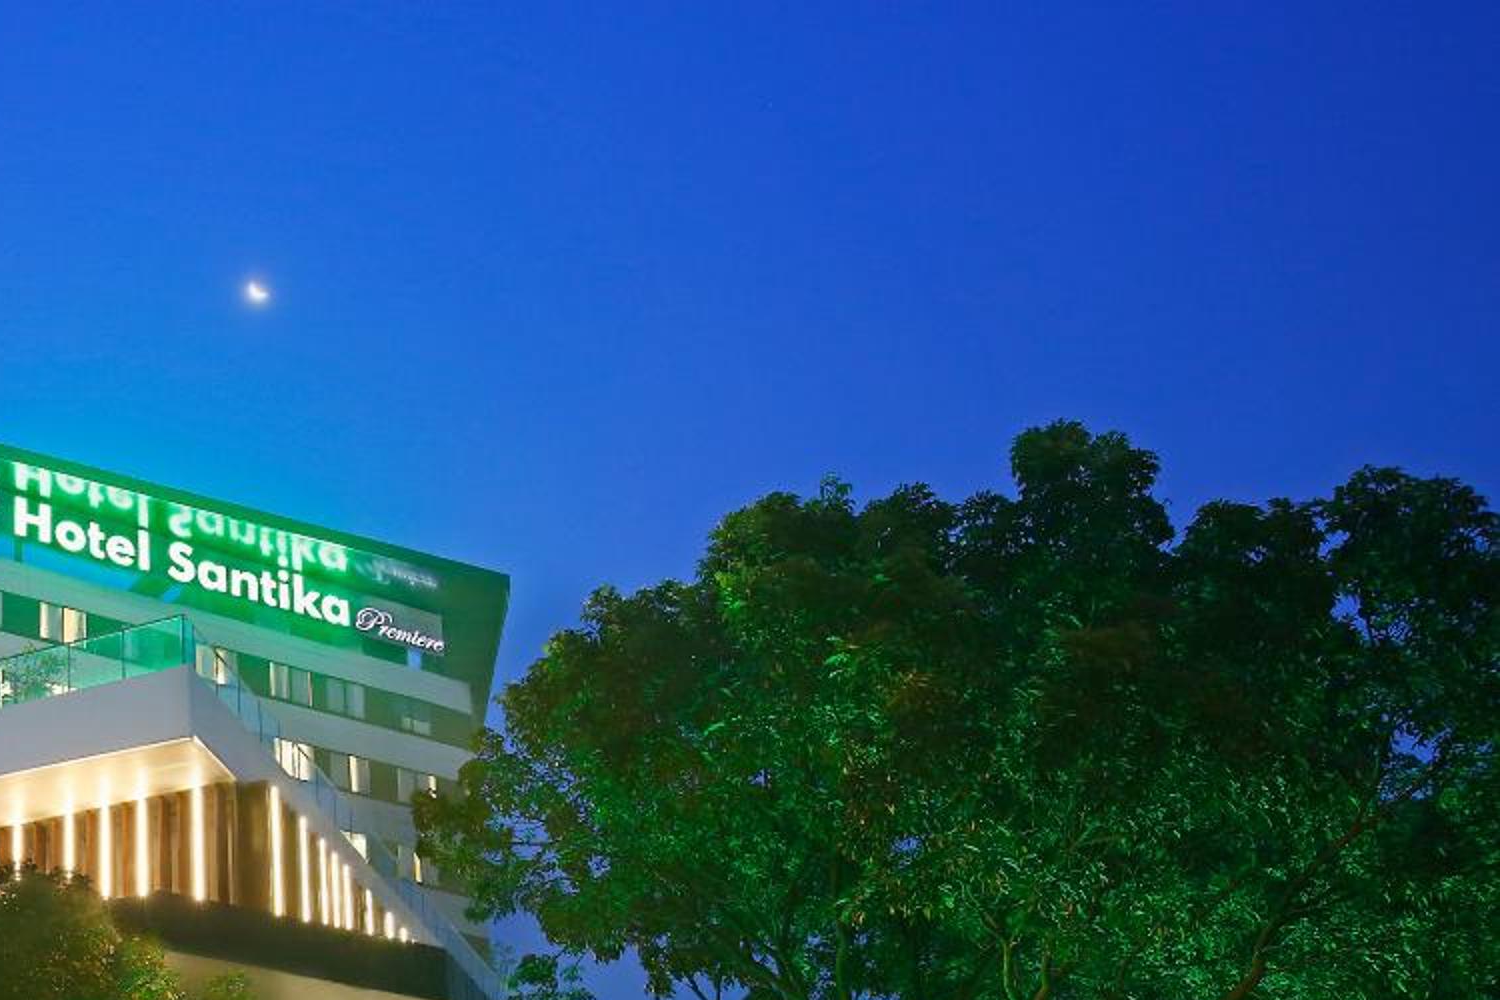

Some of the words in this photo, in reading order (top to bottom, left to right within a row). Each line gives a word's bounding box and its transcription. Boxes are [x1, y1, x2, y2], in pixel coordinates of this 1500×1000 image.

[14, 496, 150, 571] Hotel
[168, 541, 351, 627] Santika
[355, 606, 445, 652] Premiere
